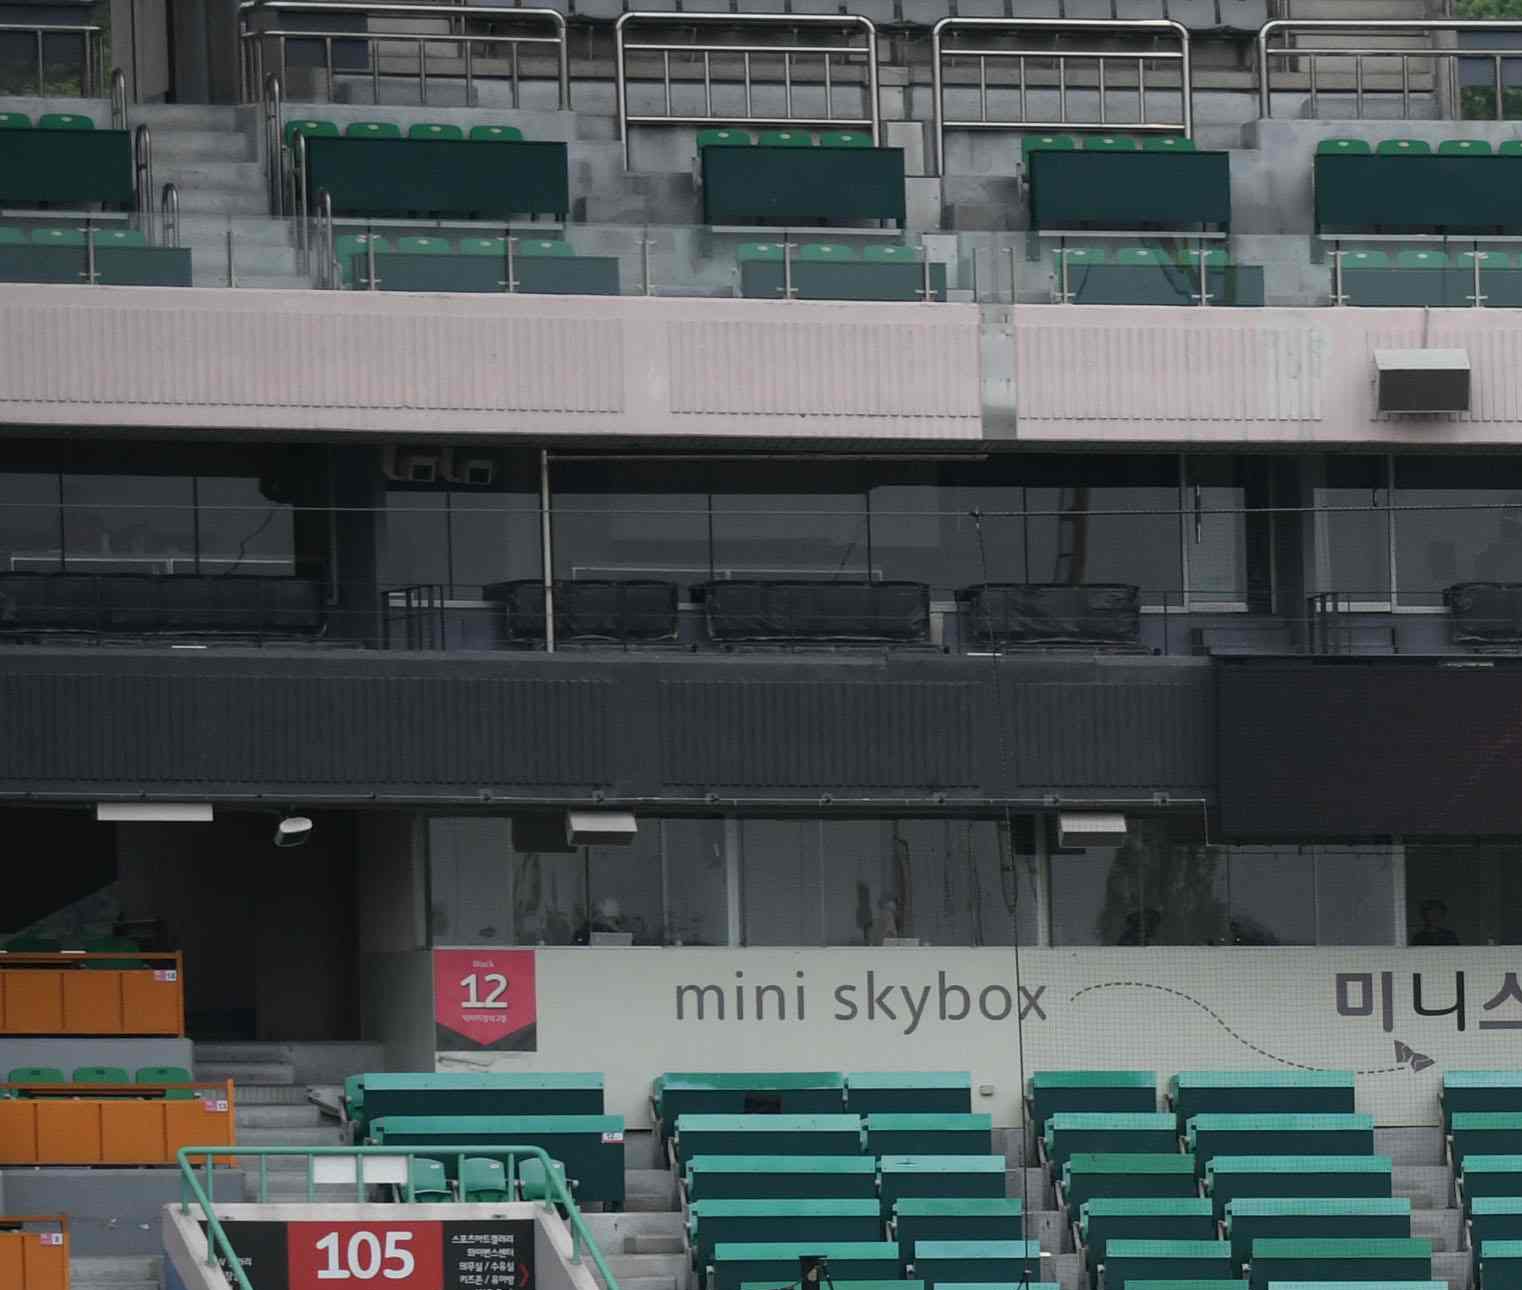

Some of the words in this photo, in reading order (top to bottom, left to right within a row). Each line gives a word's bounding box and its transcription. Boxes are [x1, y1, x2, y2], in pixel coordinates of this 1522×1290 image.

[461, 974, 508, 1009] 12
[674, 971, 807, 1022] mini
[833, 971, 1048, 1036] skybox
[315, 1230, 417, 1280] 105
